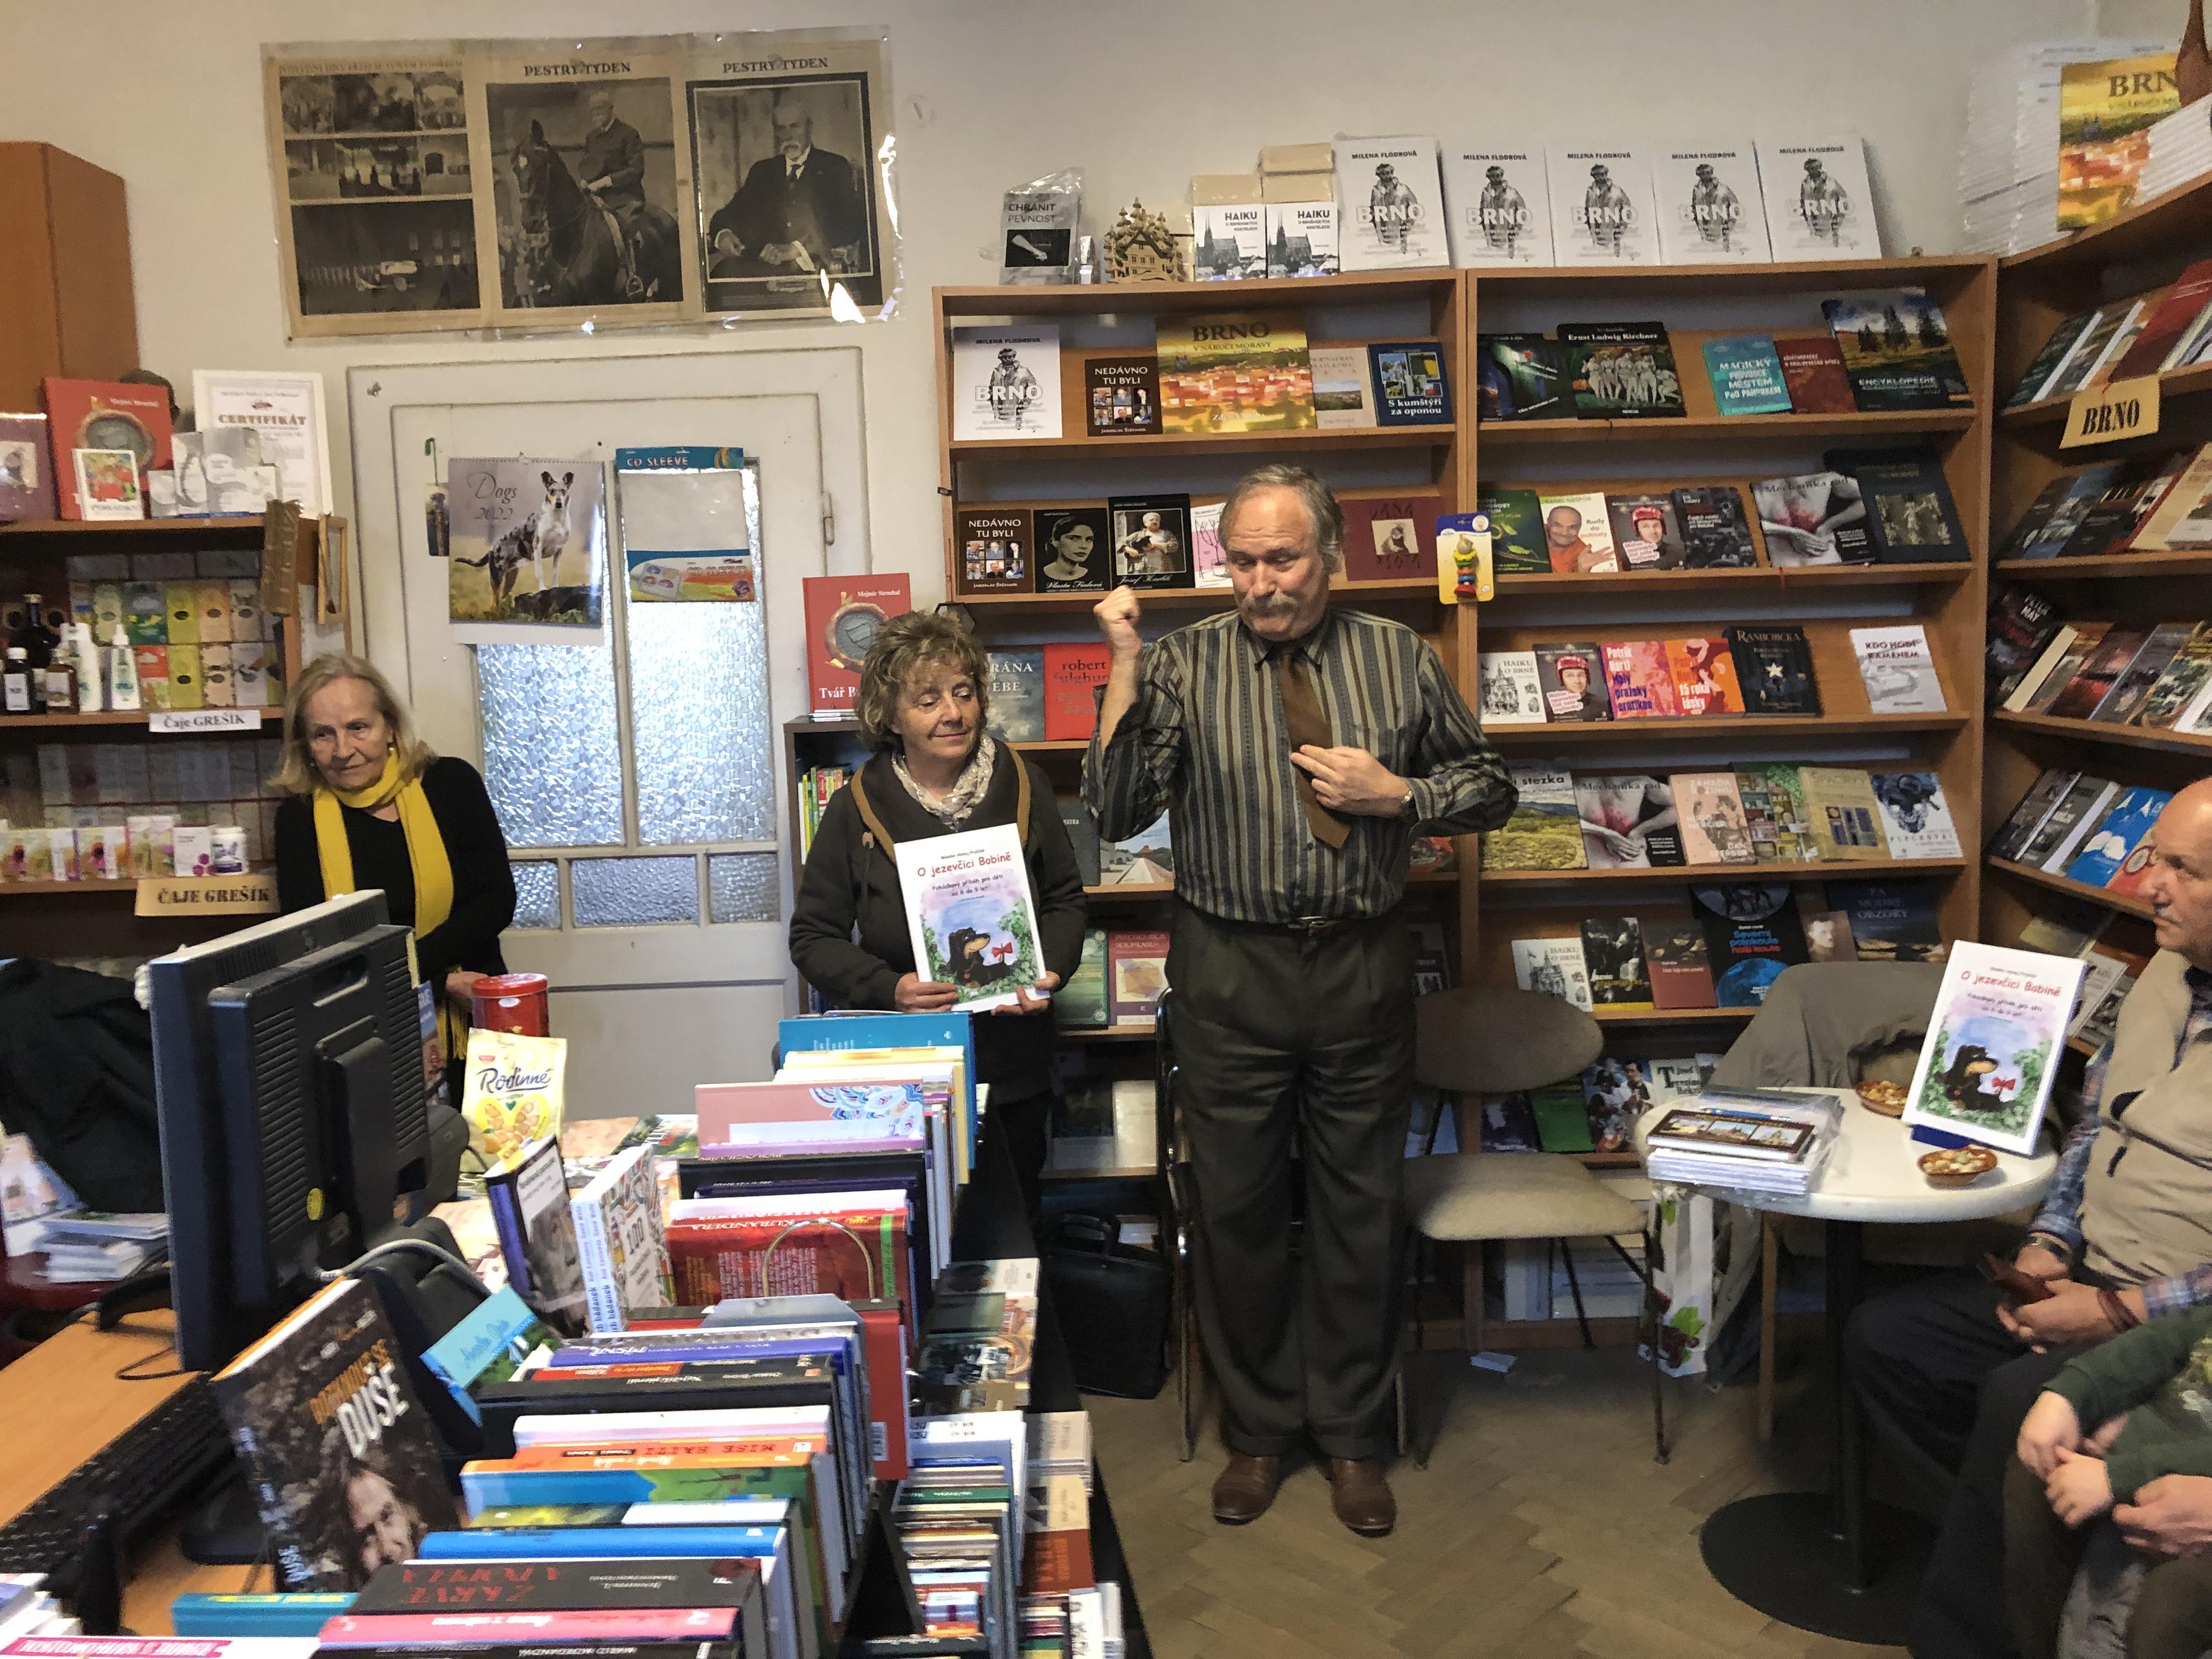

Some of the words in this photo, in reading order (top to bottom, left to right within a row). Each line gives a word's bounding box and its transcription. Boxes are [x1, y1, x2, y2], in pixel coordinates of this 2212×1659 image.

[2108, 69, 2177, 97] BRN
[1297, 210, 1330, 219] HAIKU
[1357, 204, 1425, 224] BRNO
[1571, 205, 1638, 224] BRNO
[1678, 202, 1746, 221] BRNO
[1787, 199, 1855, 218] BRNO
[1008, 215, 1057, 223] PEVNOST
[1225, 211, 1258, 221] HAIKU
[1466, 206, 1533, 225] BRNO
[1193, 322, 1271, 342] BRNO
[1094, 365, 1148, 375] NEDÁVNO
[1120, 376, 1141, 385] BYLI
[975, 384, 1043, 401] BRNO
[1404, 408, 1442, 416] oponou
[2080, 398, 2141, 437] BRNO
[218, 414, 306, 425] CERTIFIKÁT
[627, 457, 642, 467] CD
[647, 456, 688, 466] SLEEVE
[467, 471, 517, 504] Dogs
[968, 519, 1021, 528] NEDÁVNO
[992, 529, 1014, 538] BYLI
[1605, 647, 1632, 659] Patrik
[990, 661, 1033, 672] RÁNA
[1062, 659, 1107, 670] robert
[818, 686, 846, 698] Tvář
[992, 682, 1021, 692] EBE
[1679, 684, 1689, 696] 15
[163, 714, 191, 729] Čaje
[1521, 774, 1564, 785] stezka
[917, 867, 926, 877] O
[931, 859, 975, 878] jezevčici
[978, 852, 1012, 867] Bobině
[157, 887, 201, 904] ČAJE
[204, 885, 270, 903] GREŠÍK
[1961, 971, 1971, 980] O
[1973, 974, 2021, 989] jezevčici
[476, 1067, 554, 1093] Rodinné
[626, 1217, 644, 1255] 100
[336, 1360, 411, 1460] DUŠE
